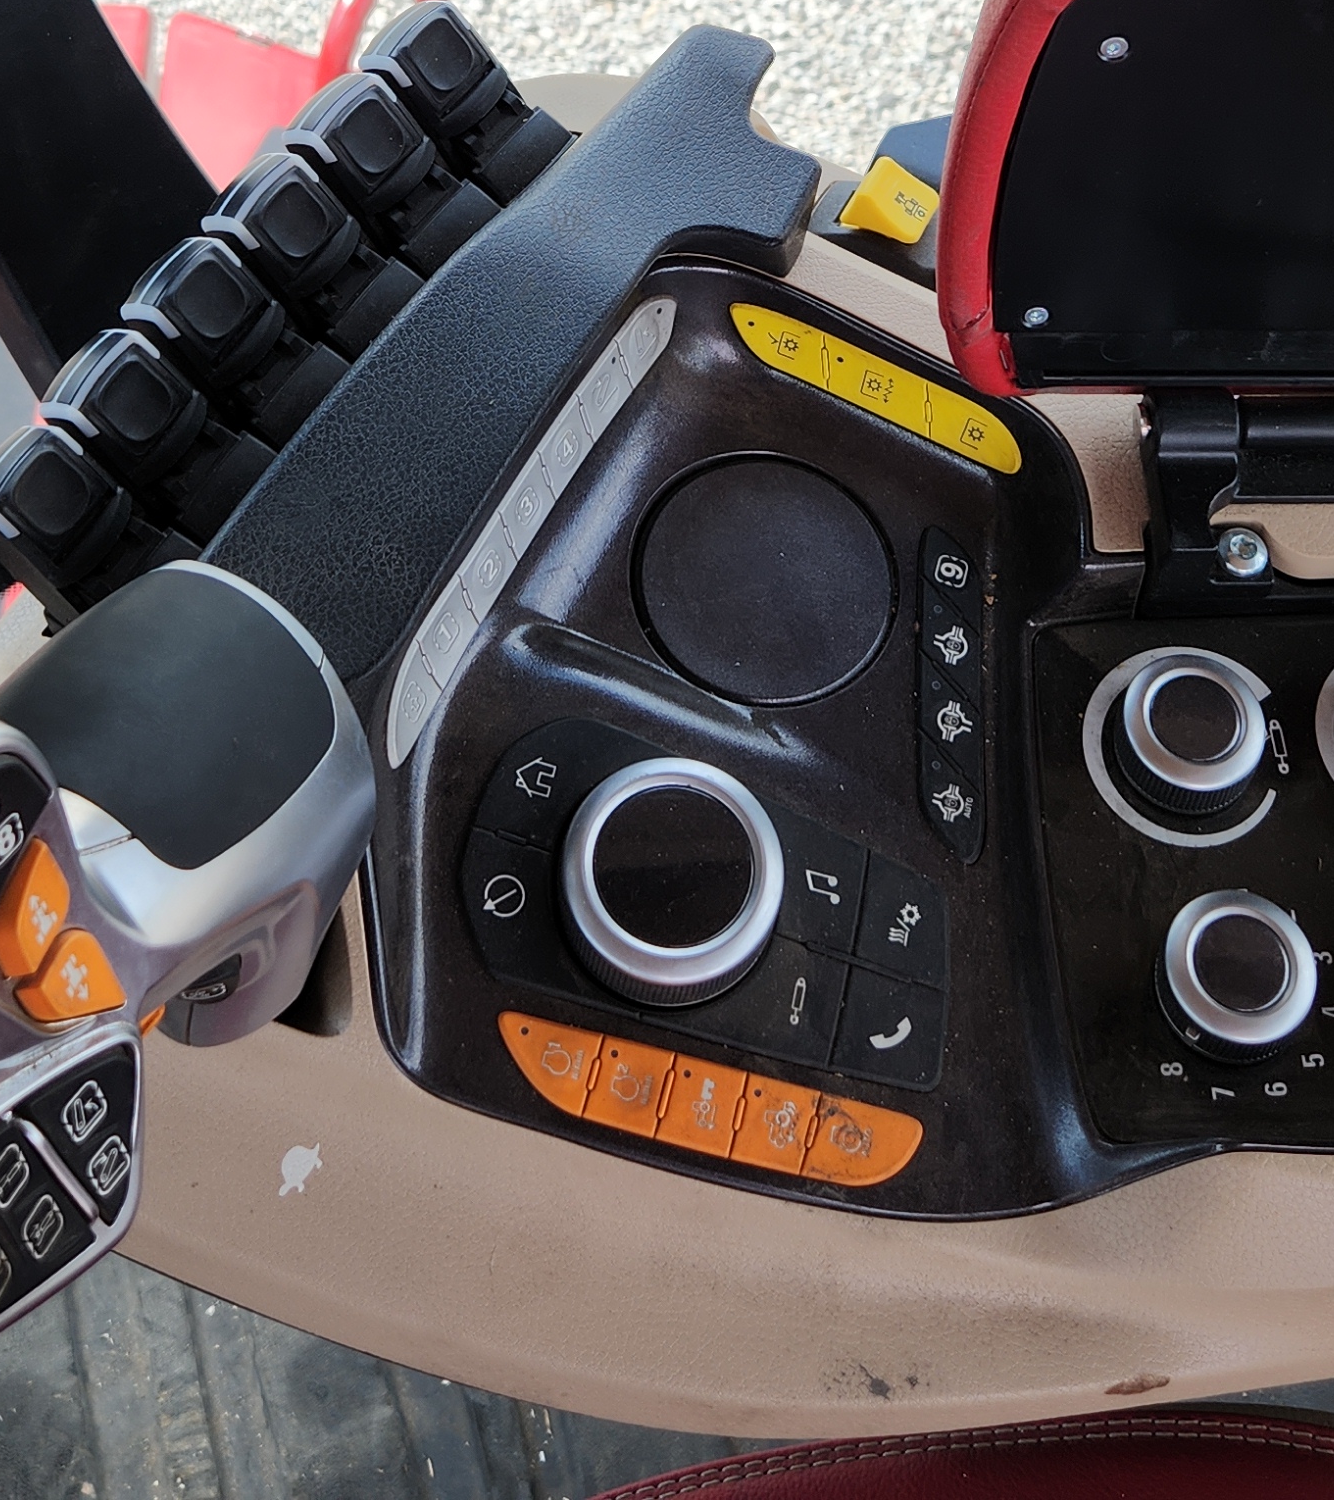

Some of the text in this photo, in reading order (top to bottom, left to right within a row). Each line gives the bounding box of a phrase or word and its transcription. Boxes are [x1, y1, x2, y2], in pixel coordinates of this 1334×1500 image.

[562, 439, 575, 458] 4
[521, 496, 535, 516] 3
[482, 558, 499, 581] 2
[940, 562, 964, 580] 9
[438, 625, 453, 641] 1
[963, 796, 974, 819] AUTO
[1312, 951, 1333, 964] 3
[1300, 1052, 1325, 1068] 5
[617, 1063, 629, 1074] 2
[1160, 1061, 1183, 1076] 8
[1210, 1087, 1236, 1100] 7
[1264, 1082, 1288, 1097] 6
